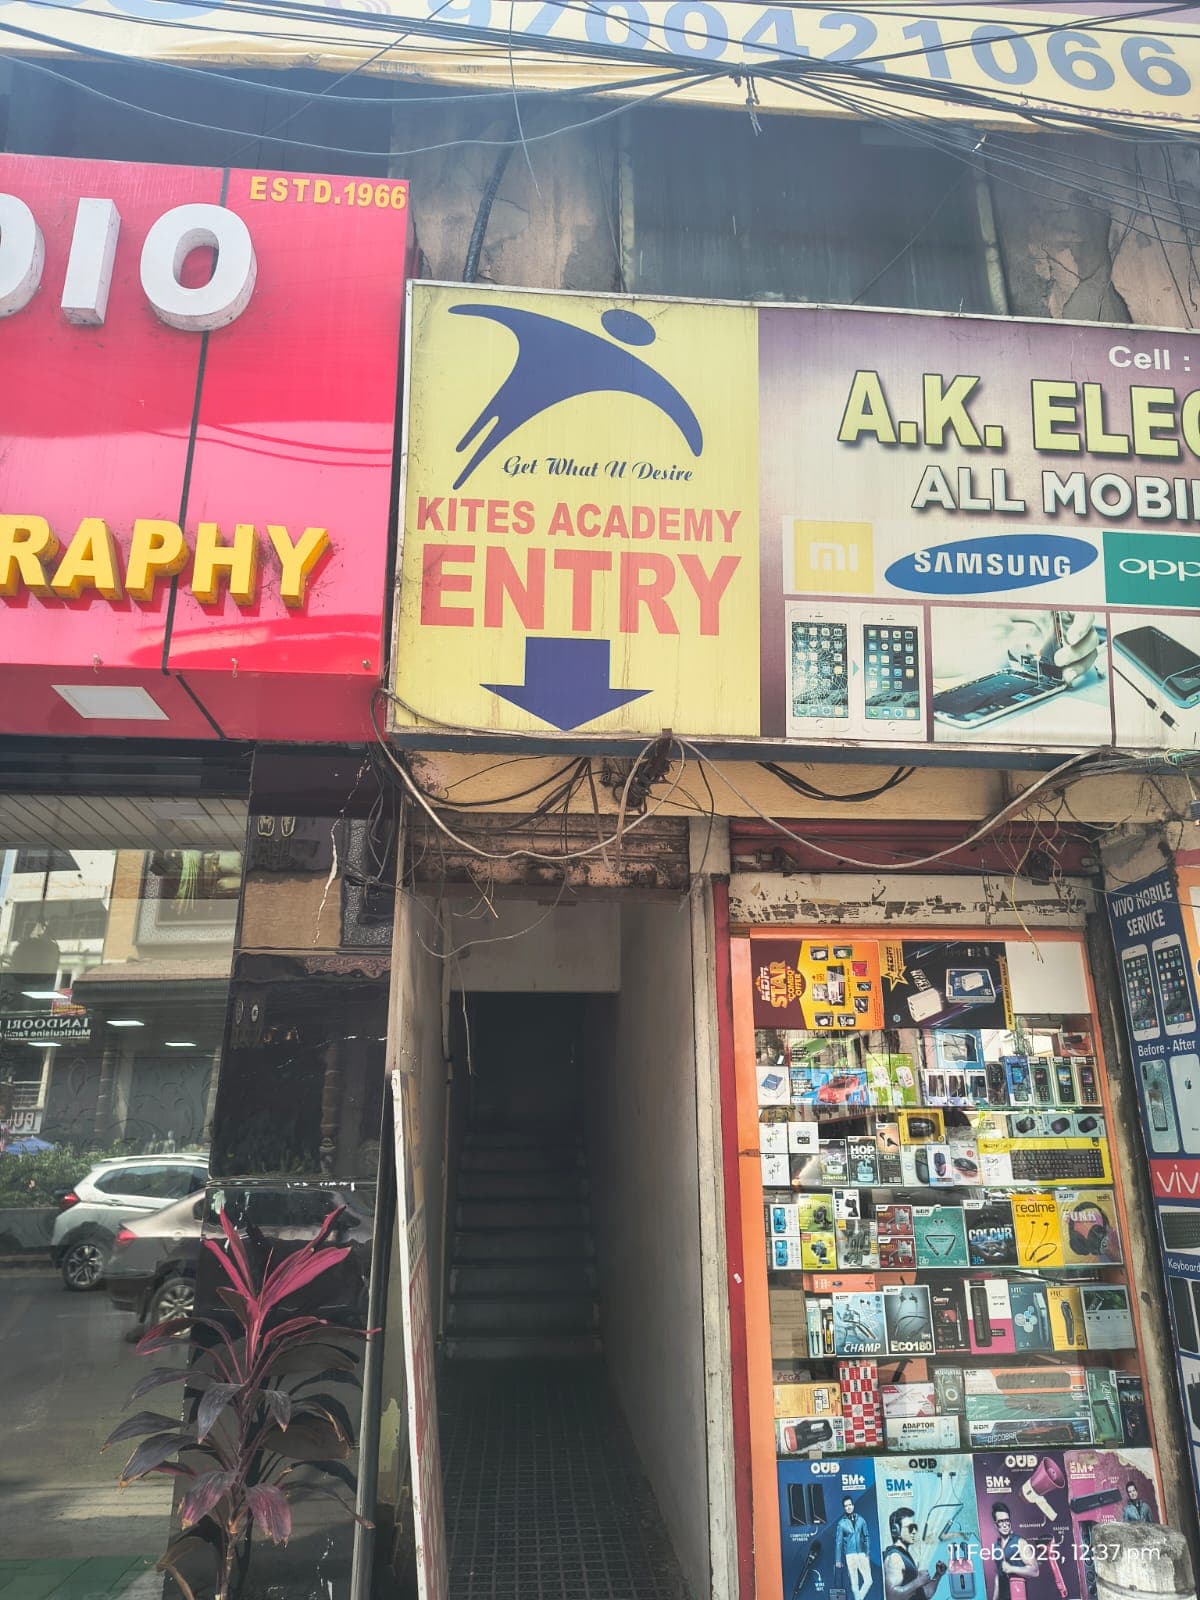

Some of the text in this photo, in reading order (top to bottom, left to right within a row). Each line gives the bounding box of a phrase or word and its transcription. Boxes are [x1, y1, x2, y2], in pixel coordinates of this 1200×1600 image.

[250, 176, 406, 209] ESTD.1966
[1108, 345, 1170, 370] Cell
[838, 370, 1003, 447] A.K.
[502, 455, 693, 482] Get What U Desire
[911, 465, 1026, 512] ALL
[417, 496, 742, 543] KITES ACADEMY
[913, 551, 1071, 577] SAMSUNG
[420, 543, 742, 636] ENTRY
[1112, 881, 1172, 918] VIVO MOBILE
[1127, 909, 1165, 937] SERVICE
[769, 960, 788, 1009] STAR
[1138, 1044, 1165, 1057] Before
[1172, 1038, 1196, 1052] After
[850, 1145, 875, 1155] HOP
[1015, 1202, 1056, 1214] realme
[968, 1227, 1014, 1242] COLOUR
[843, 1342, 881, 1353] CHAMP
[891, 1341, 932, 1352] ECO180
[811, 1463, 840, 1474] OUD
[908, 1458, 937, 1470] OUD
[1005, 1455, 1038, 1467] OUD
[1069, 1462, 1095, 1473] 5M+
[841, 1474, 865, 1485] 5M+
[886, 1479, 912, 1491] 5M+
[986, 1476, 1011, 1487] 5M+
